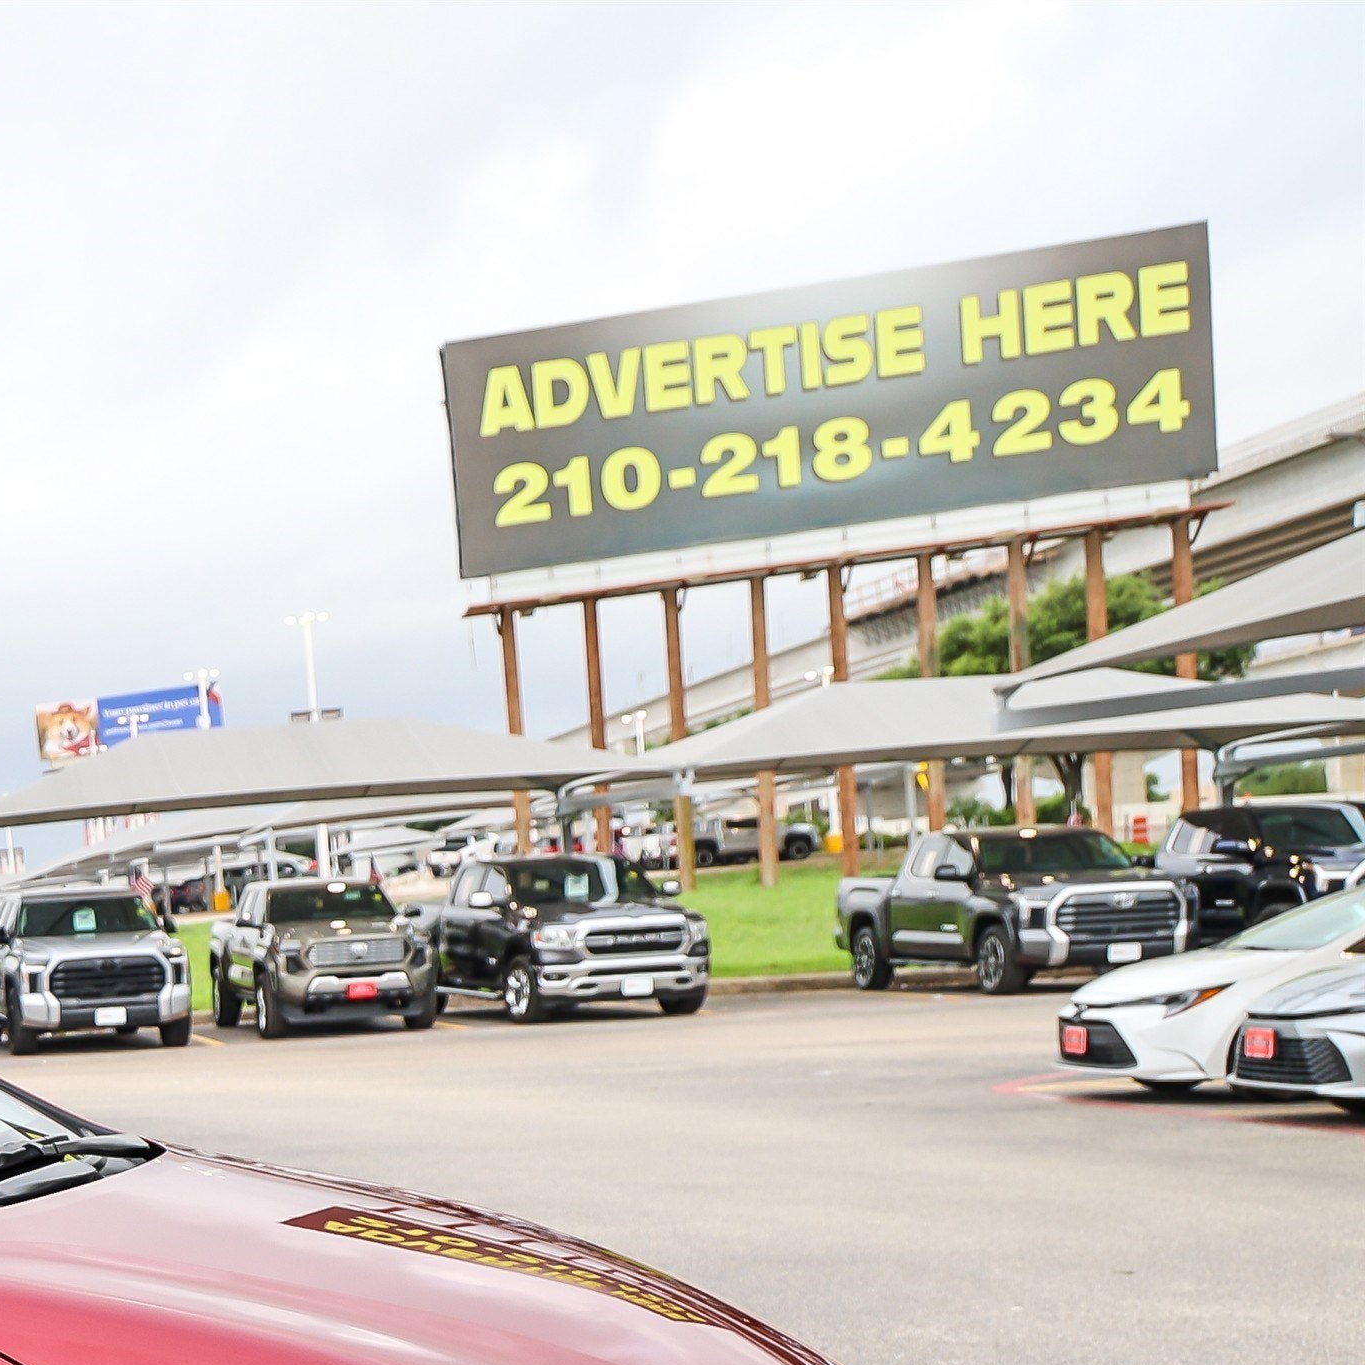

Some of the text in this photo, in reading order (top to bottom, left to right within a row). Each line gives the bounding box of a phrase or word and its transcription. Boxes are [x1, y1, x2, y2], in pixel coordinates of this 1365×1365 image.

[480, 260, 1193, 438] ADVERTISE HERE
[493, 368, 1191, 529] 210-218-4234
